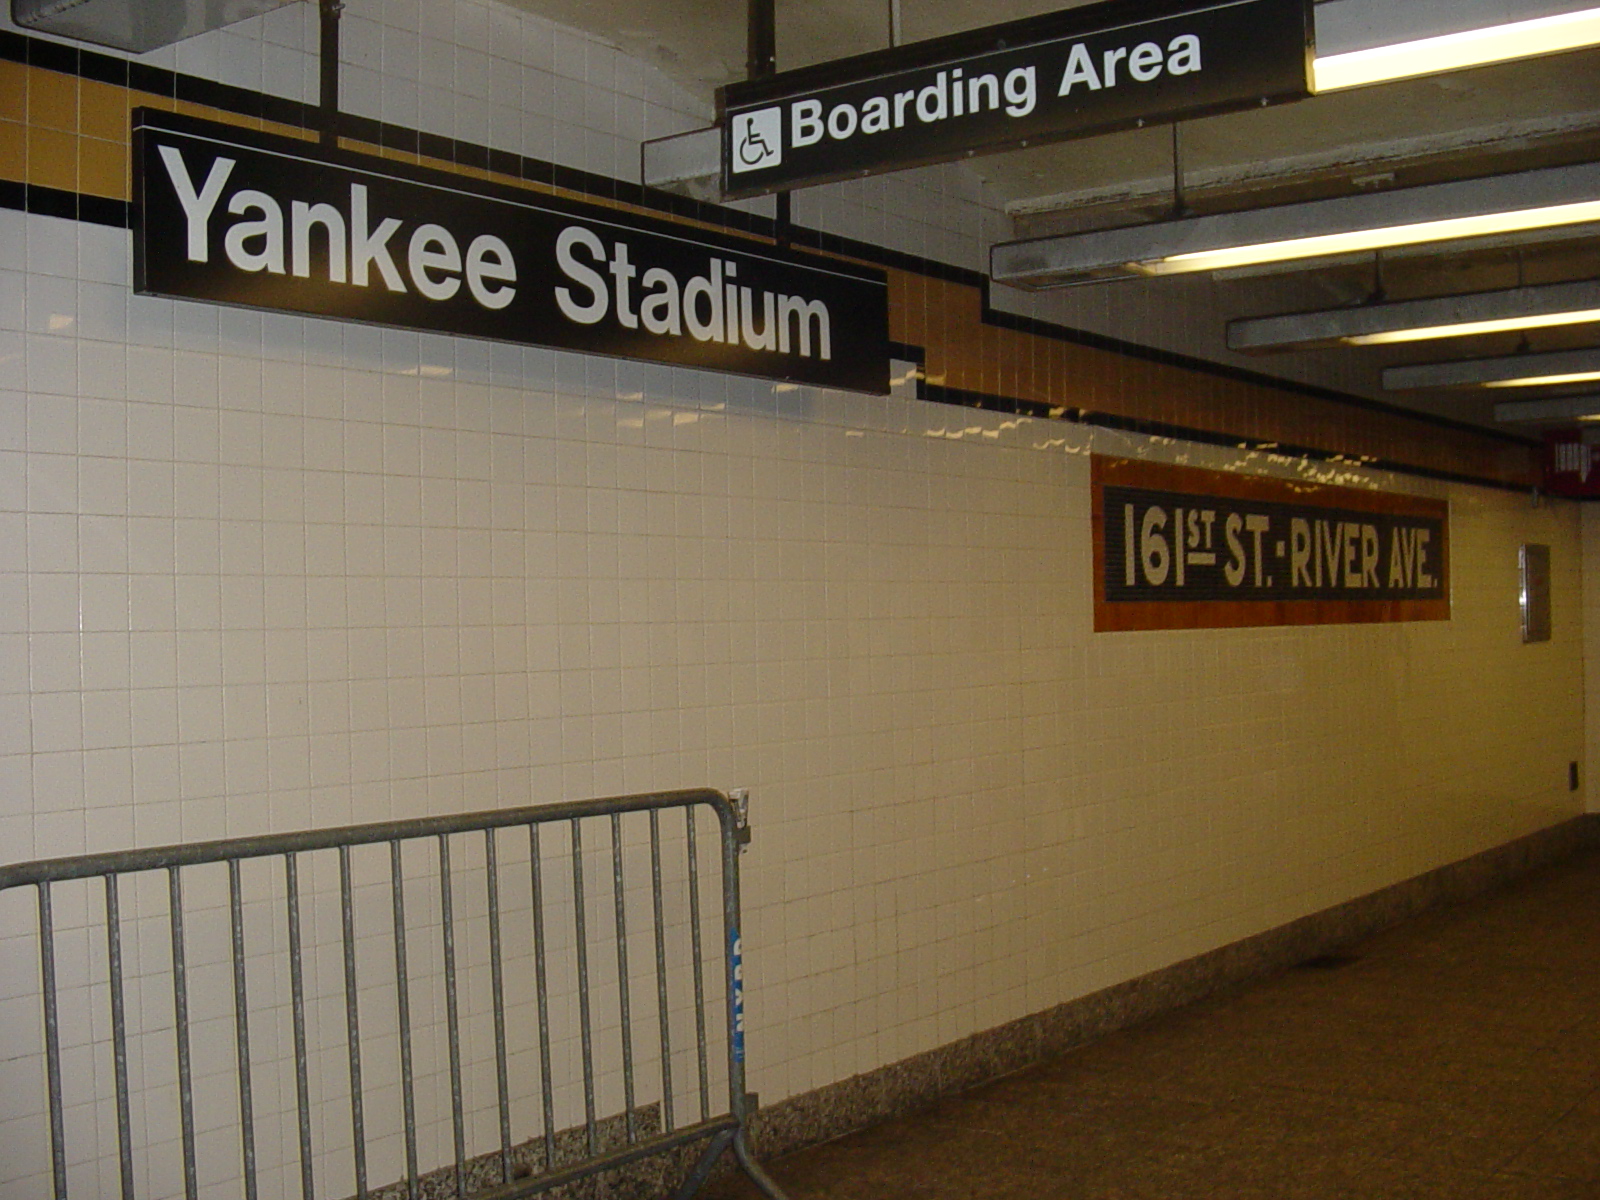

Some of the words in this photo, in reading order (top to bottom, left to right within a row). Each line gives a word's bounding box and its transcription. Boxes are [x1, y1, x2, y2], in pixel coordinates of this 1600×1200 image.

[790, 63, 1038, 149] Boarding
[1057, 33, 1202, 97] Area
[157, 145, 518, 312] Yankee
[554, 225, 833, 362] Stadium
[1388, 526, 1439, 588] AVE.
